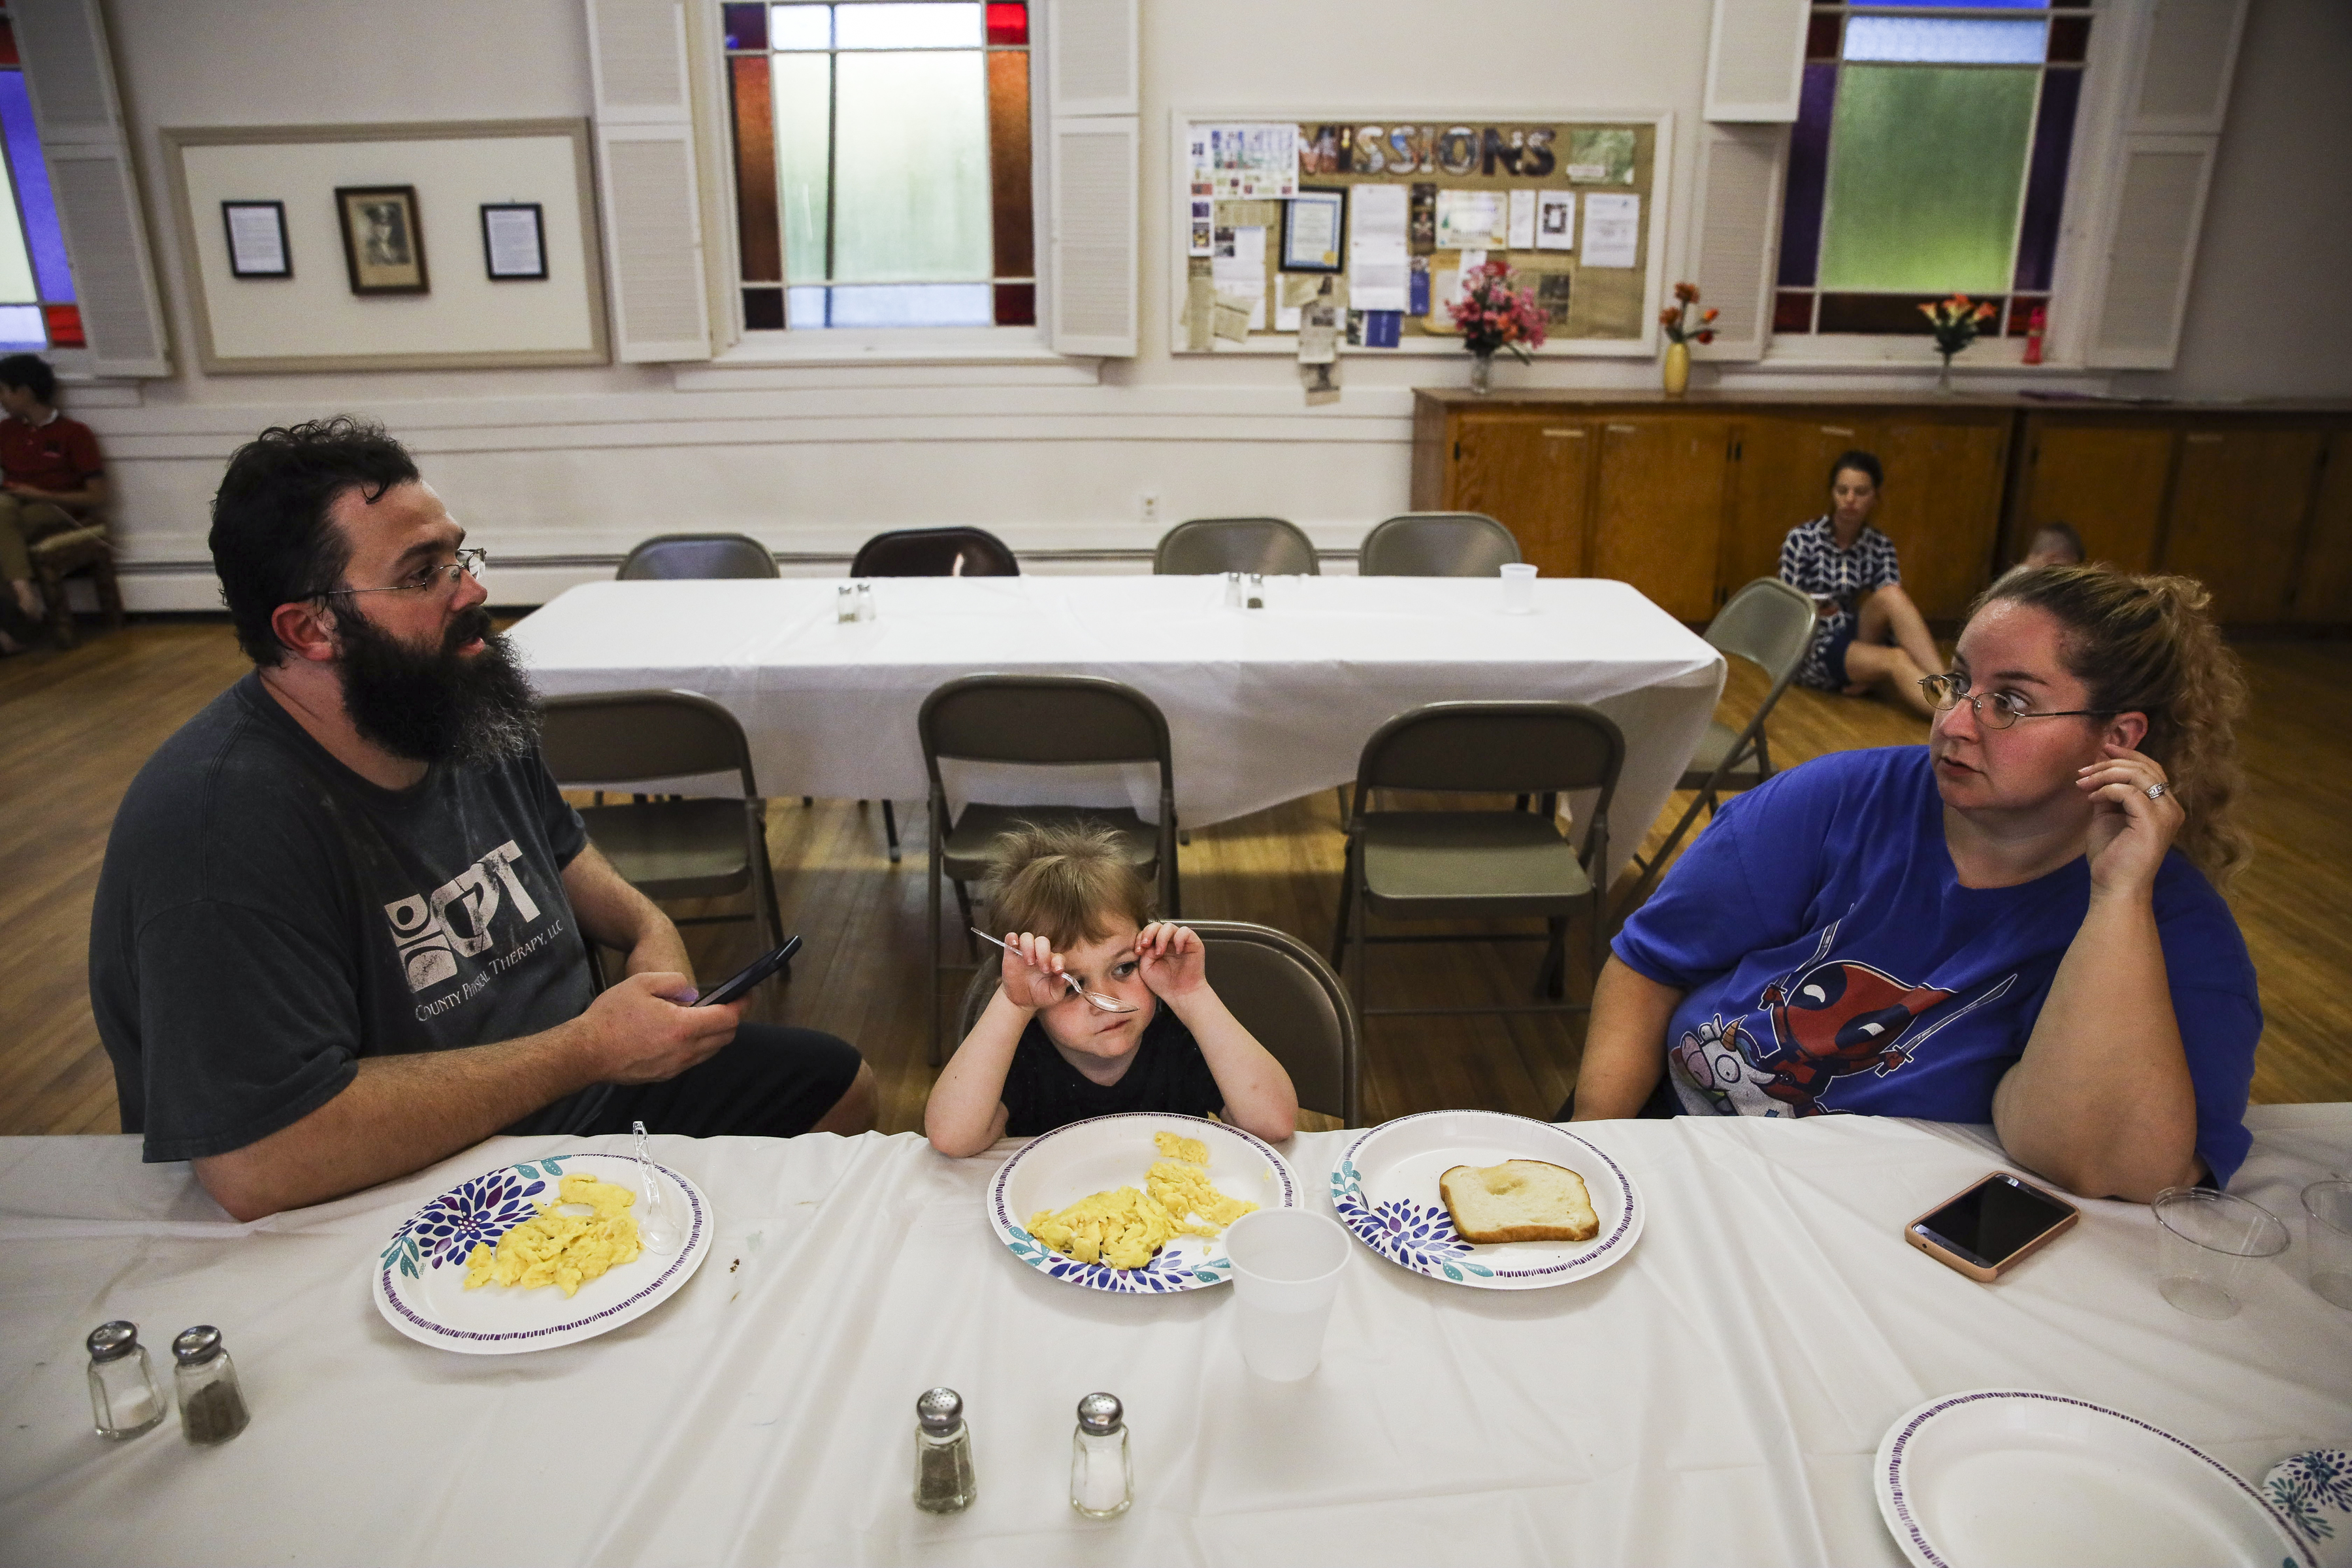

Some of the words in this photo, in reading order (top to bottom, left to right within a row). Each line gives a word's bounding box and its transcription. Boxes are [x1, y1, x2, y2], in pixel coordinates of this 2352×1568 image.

[1298, 125, 1556, 176] MISSIONS
[416, 991, 461, 1021] COUNTY
[489, 933, 547, 974] THERAPY,
[547, 919, 564, 939] LLC
